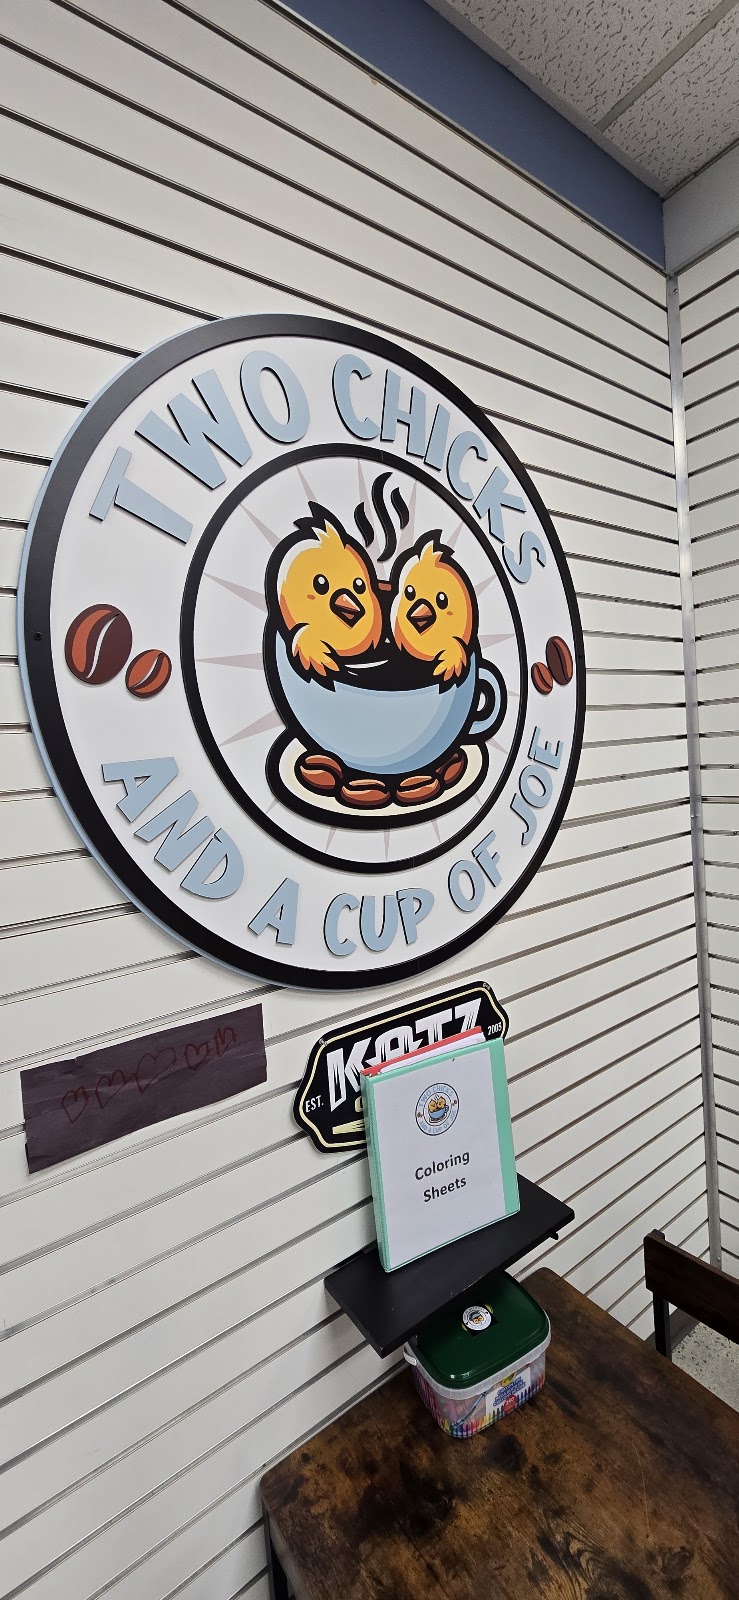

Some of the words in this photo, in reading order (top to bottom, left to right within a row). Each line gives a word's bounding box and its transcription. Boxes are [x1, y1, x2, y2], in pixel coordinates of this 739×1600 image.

[89, 350, 310, 545] TWO
[332, 354, 546, 584] CHICKS
[101, 756, 245, 899] AND
[248, 877, 300, 945] A
[323, 886, 434, 957] CUP
[448, 831, 502, 912] OF
[512, 726, 563, 845] JOE
[305, 1095, 324, 1113] EST.
[419, 1090, 431, 1107] TWO
[433, 1085, 454, 1097] CHICKS
[415, 1152, 470, 1180] Coloring
[423, 1177, 467, 1203] Sheets
